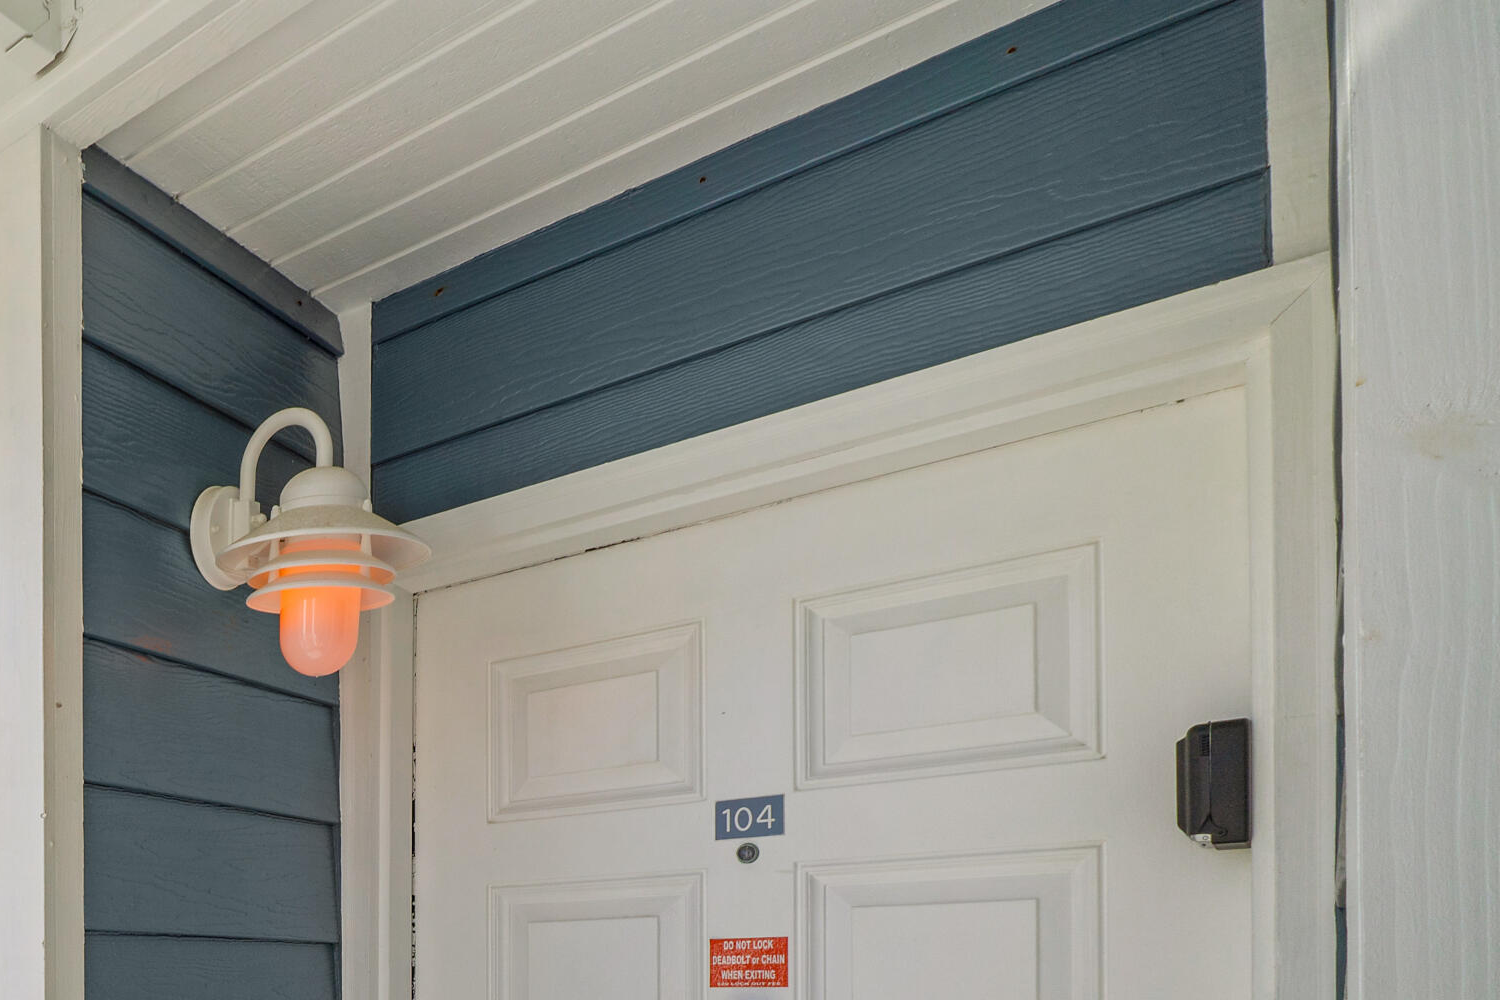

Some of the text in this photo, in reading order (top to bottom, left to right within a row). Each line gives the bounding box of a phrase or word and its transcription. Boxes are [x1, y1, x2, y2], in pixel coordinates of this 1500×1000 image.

[722, 804, 775, 833] 104
[723, 939, 774, 950] DO NOT LOCK
[712, 954, 786, 965] DEADBOLT or CHAIN
[721, 969, 776, 980] WHEN EXITING
